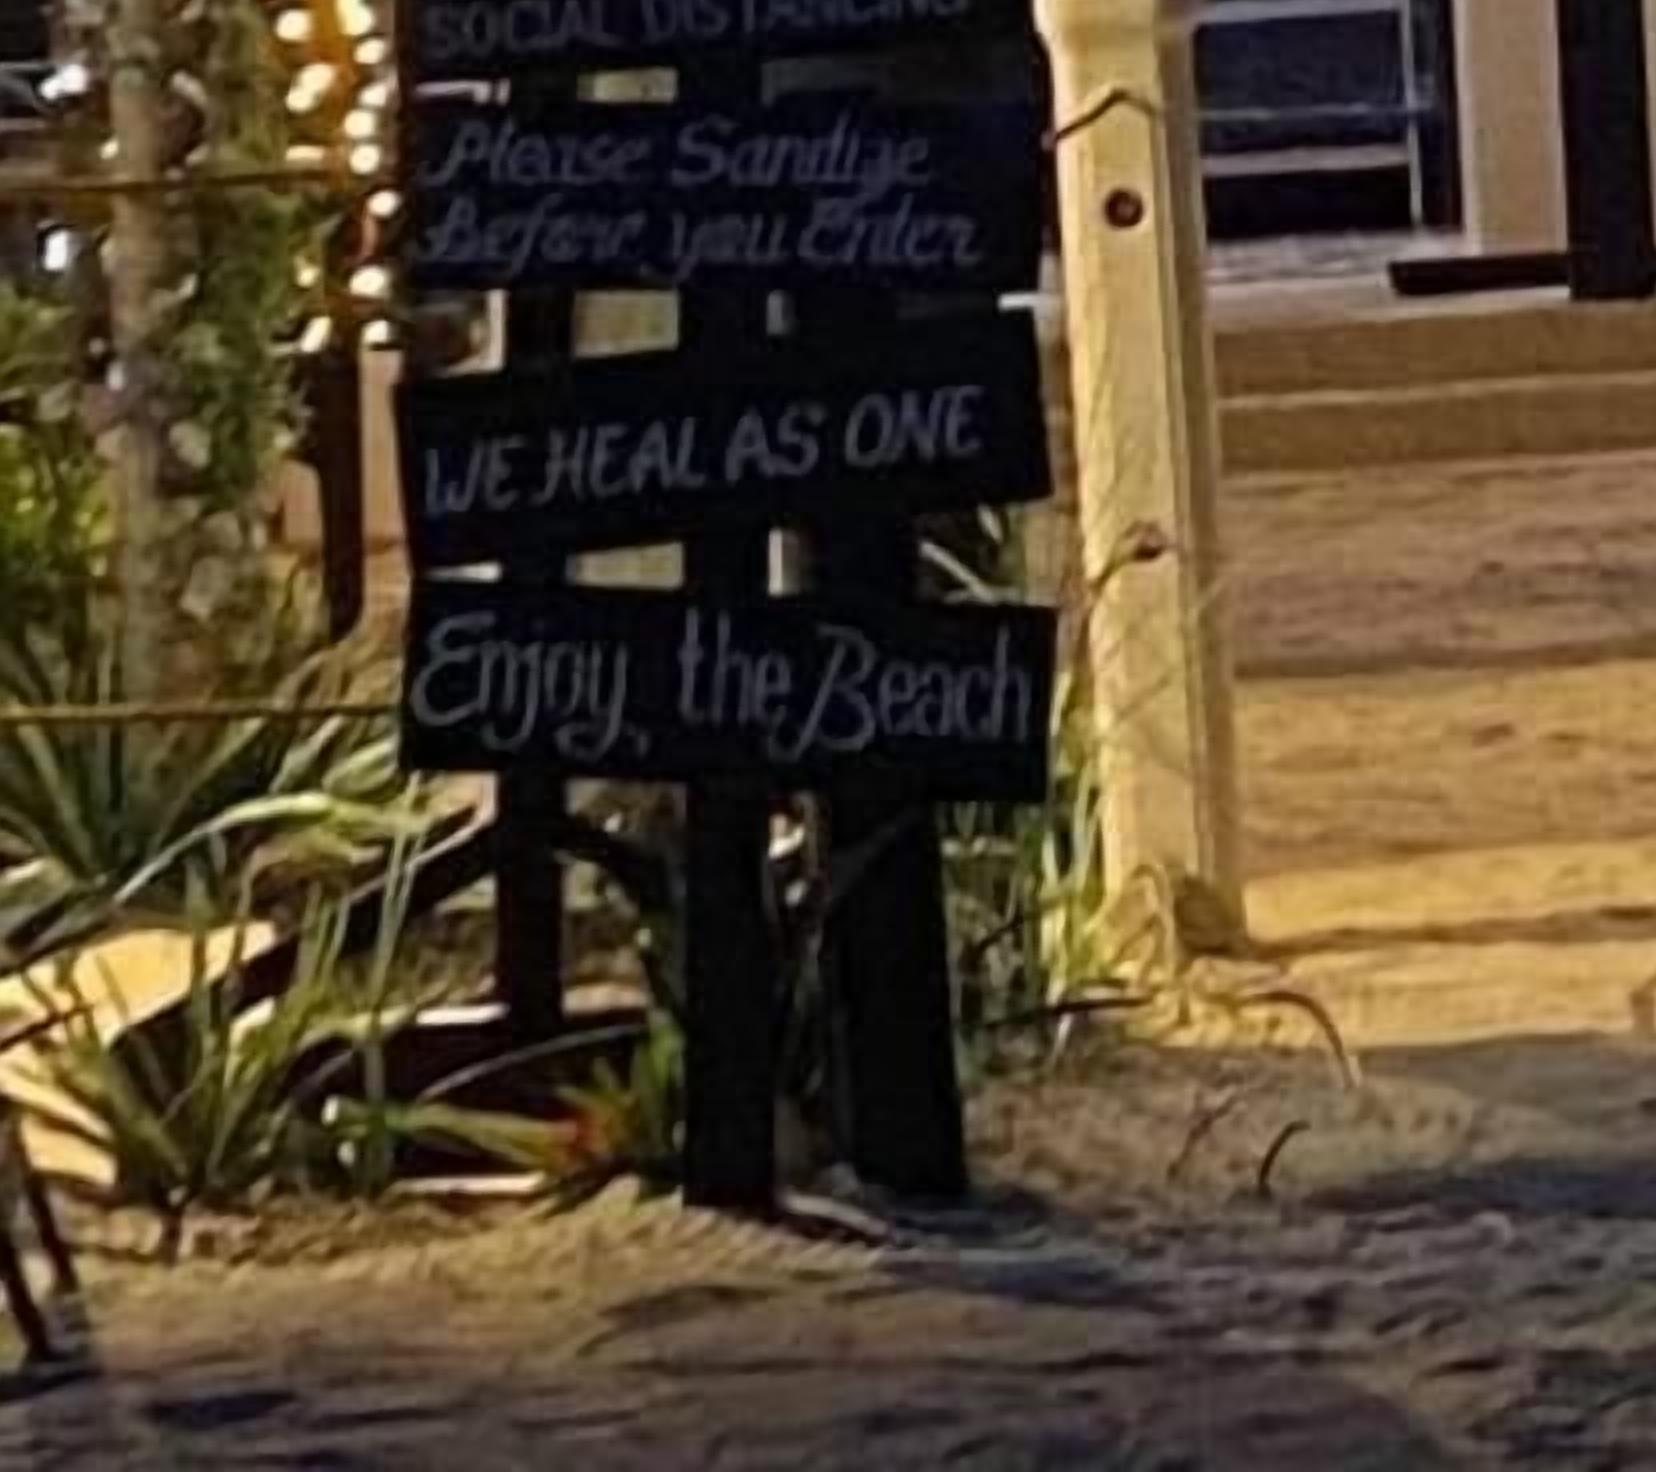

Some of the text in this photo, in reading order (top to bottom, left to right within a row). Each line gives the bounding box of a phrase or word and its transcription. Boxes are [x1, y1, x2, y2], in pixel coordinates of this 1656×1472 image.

[669, 207, 787, 284] you
[424, 384, 989, 517] WE HEAL AS ONE
[677, 607, 795, 725] the
[768, 621, 1033, 755] Beach
